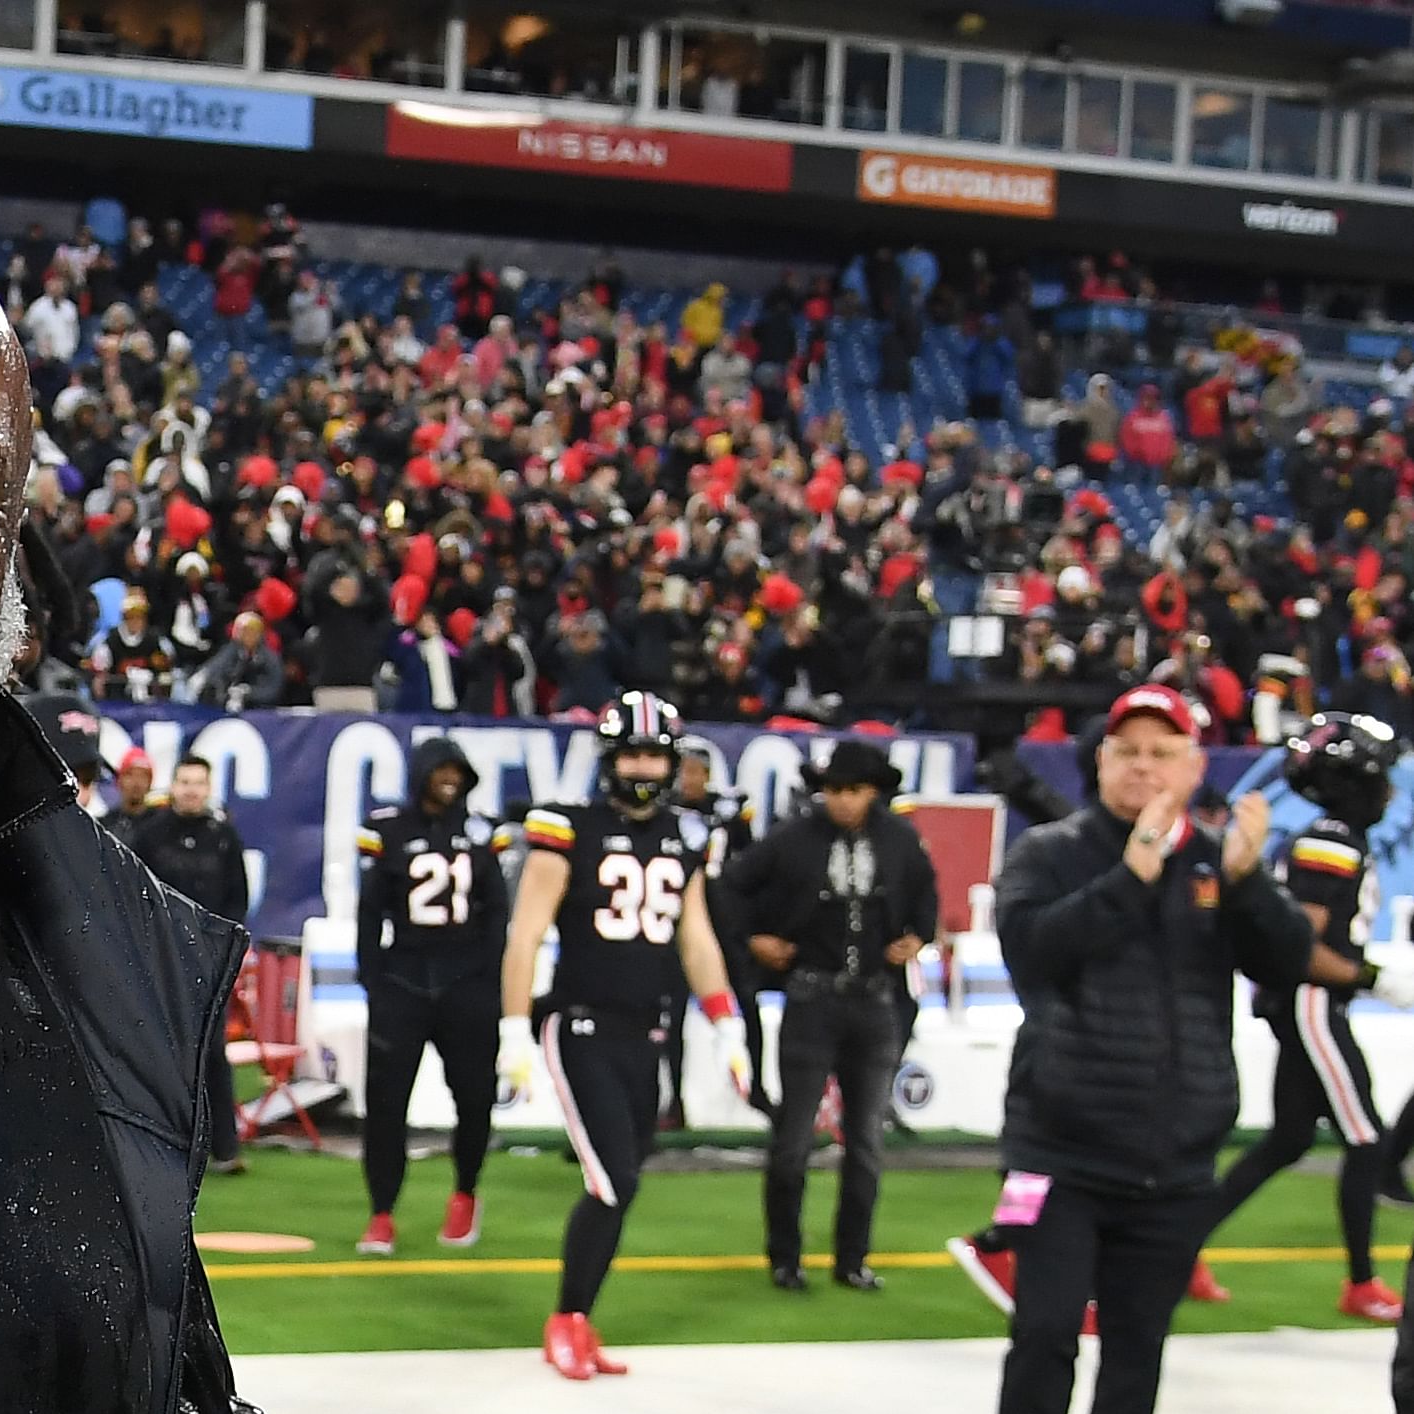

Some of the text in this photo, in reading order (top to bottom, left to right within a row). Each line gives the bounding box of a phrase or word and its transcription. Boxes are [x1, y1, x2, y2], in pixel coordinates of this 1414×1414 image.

[20, 76, 250, 137] Gallagher
[518, 128, 669, 168] NISSAN
[901, 164, 1051, 207] GATORADE
[1243, 200, 1339, 237] verizon
[407, 850, 473, 927] 21
[594, 852, 685, 945] 36
